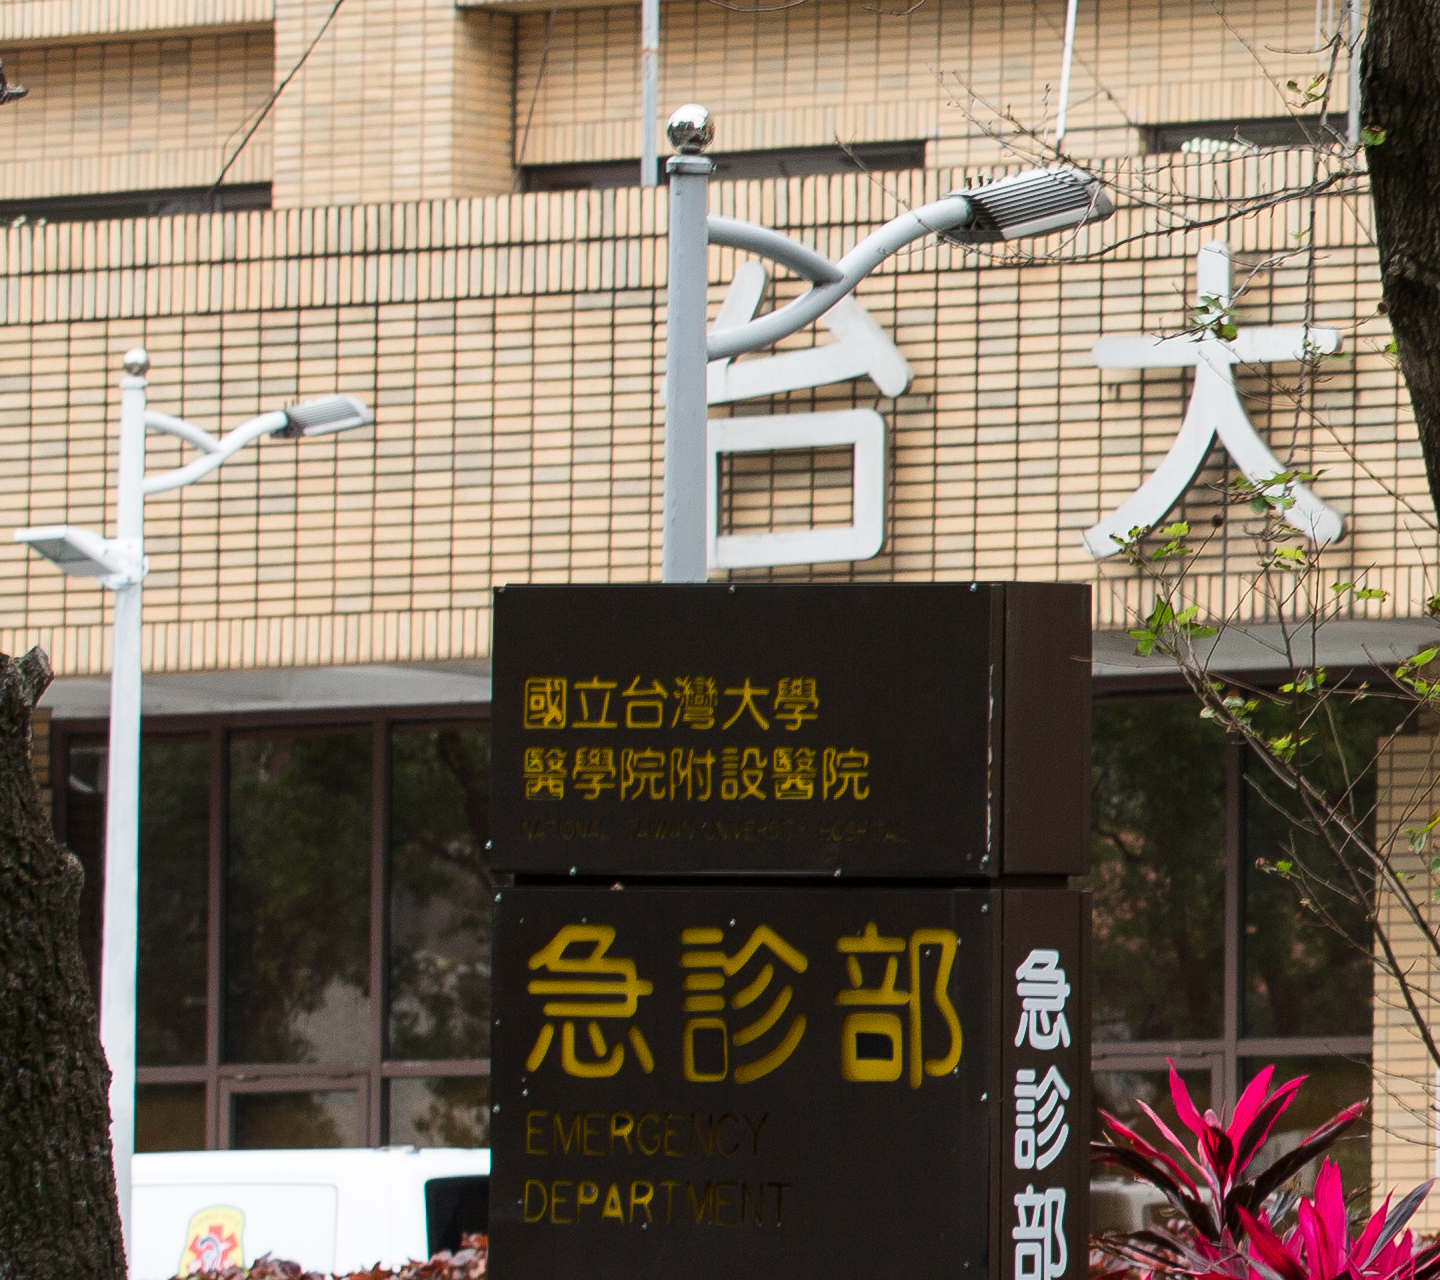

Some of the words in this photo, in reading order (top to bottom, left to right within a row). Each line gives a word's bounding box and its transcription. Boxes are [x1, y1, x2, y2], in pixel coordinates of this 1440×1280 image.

[523, 676, 820, 731] 國立台灣大學
[523, 746, 871, 802] 醫學院附設醫院
[526, 922, 965, 1089] 急診部
[525, 1109, 770, 1157] EMERGENCY
[523, 1178, 793, 1225] DEPARTMENT
